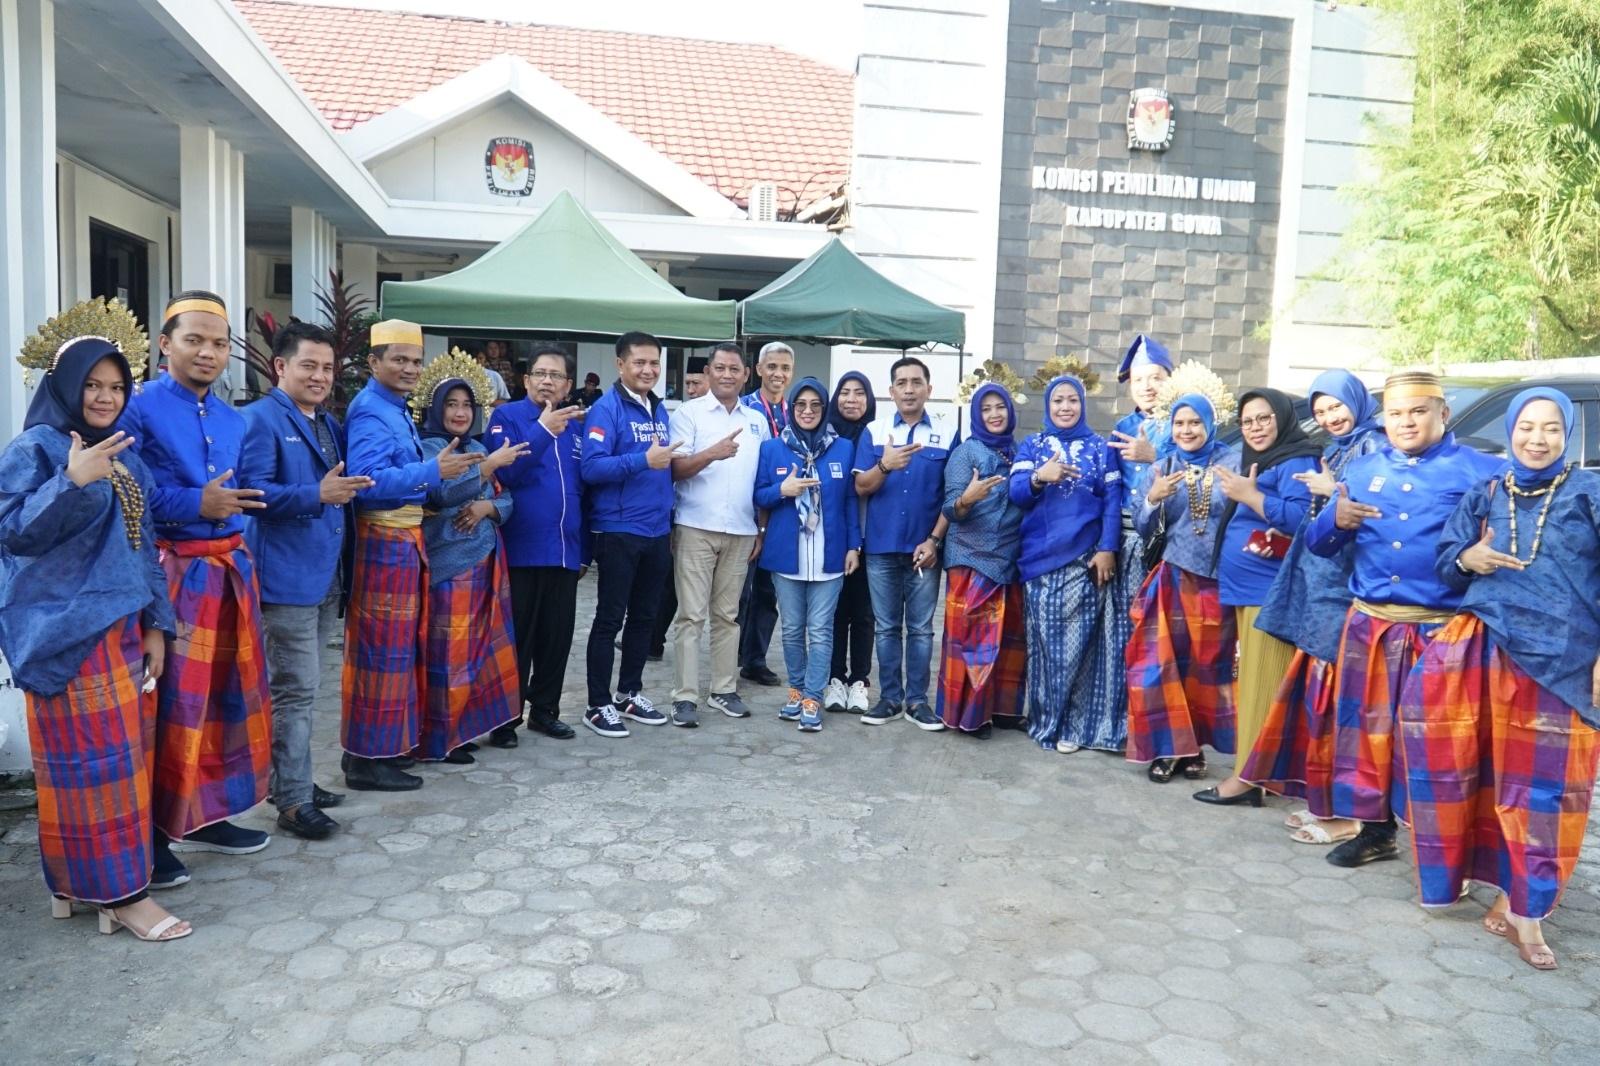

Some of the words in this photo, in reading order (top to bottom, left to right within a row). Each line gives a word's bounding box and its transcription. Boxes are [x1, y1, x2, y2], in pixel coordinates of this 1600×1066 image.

[496, 139, 526, 147] KOMISI
[1032, 166, 1098, 192] KOMISI
[1102, 171, 1198, 199] PEMILIHAN
[1202, 178, 1256, 203] UMUM
[1066, 206, 1166, 231] KABUPATEN
[1172, 213, 1222, 235] GOWA
